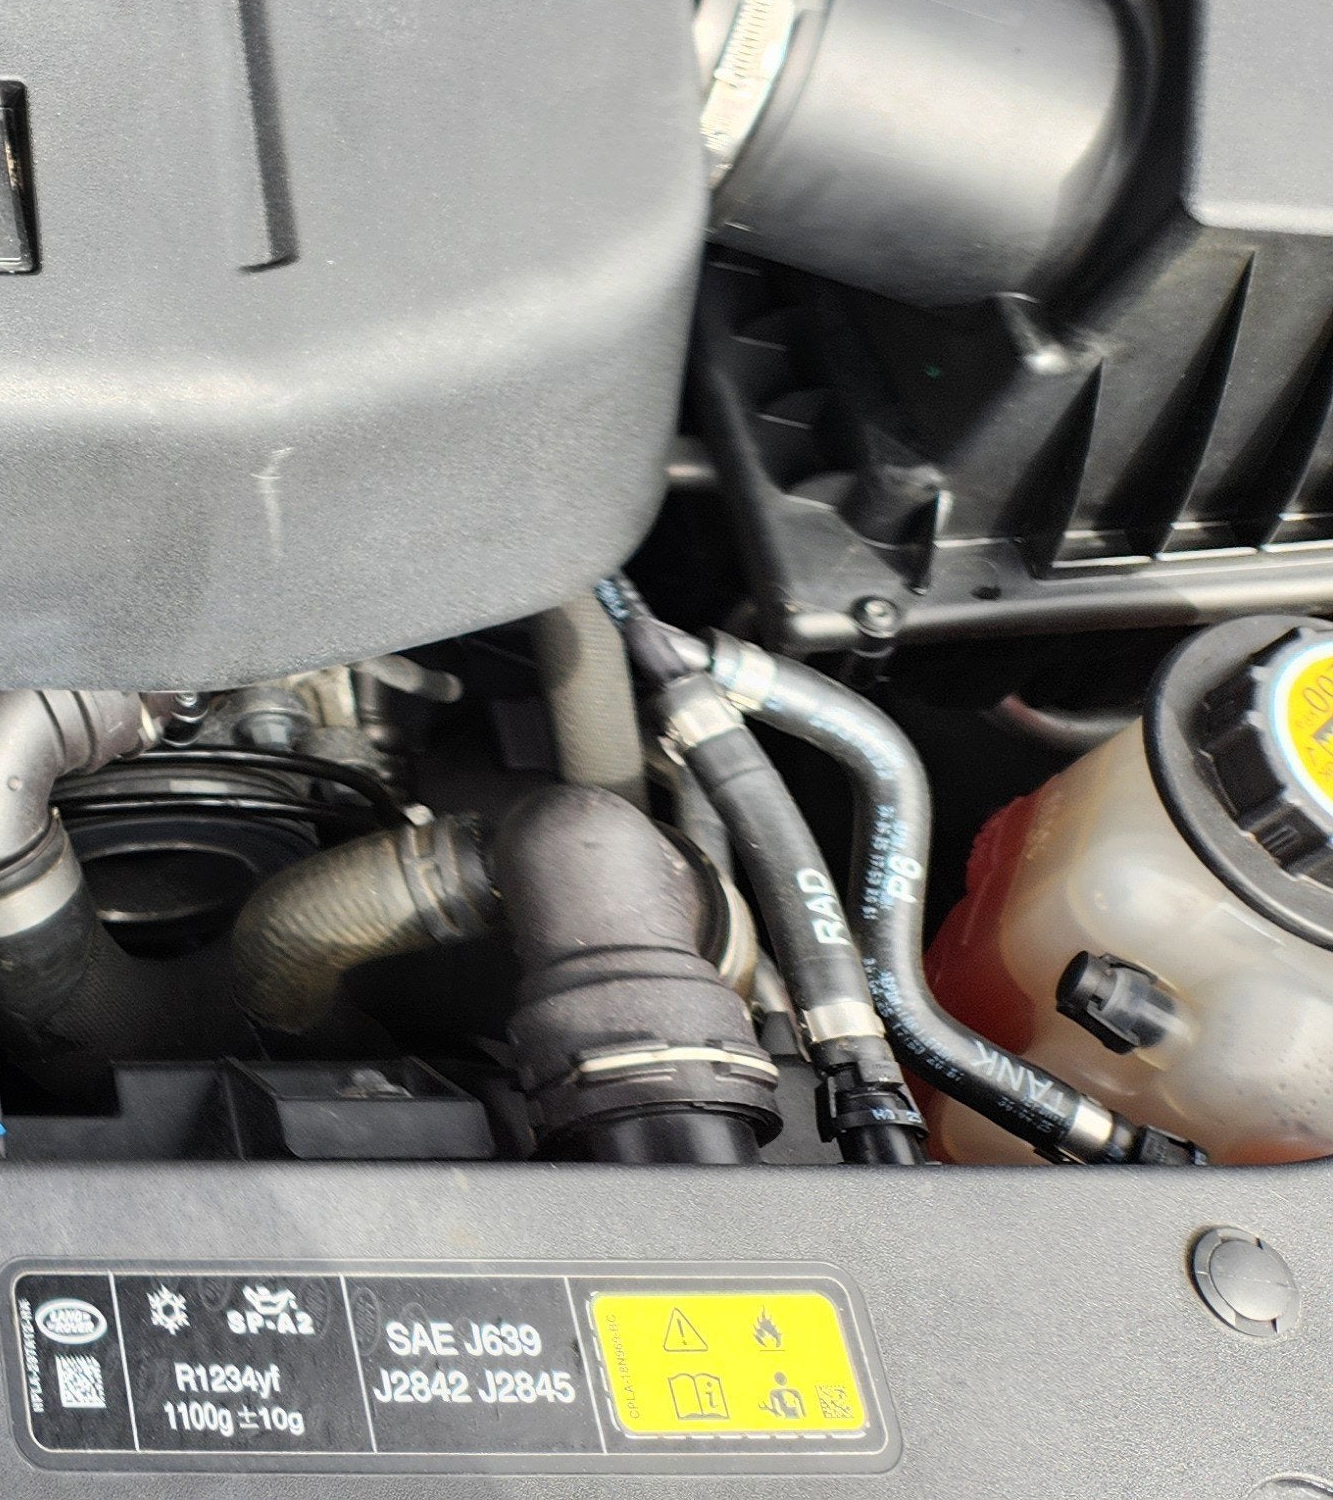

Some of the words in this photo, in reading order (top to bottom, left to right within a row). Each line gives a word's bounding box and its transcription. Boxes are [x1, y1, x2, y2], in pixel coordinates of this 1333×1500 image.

[885, 854, 922, 904] P6
[796, 866, 852, 946] RAD
[968, 1039, 1067, 1119] TANK
[227, 1311, 315, 1335] SP-A2
[386, 1321, 459, 1357] SAE
[466, 1323, 542, 1357] J639
[174, 1362, 281, 1399] R1234yf
[373, 1367, 474, 1404] J2842
[478, 1368, 576, 1404] J2845
[163, 1400, 233, 1437] 1100g
[238, 1403, 305, 1436] ±10g
